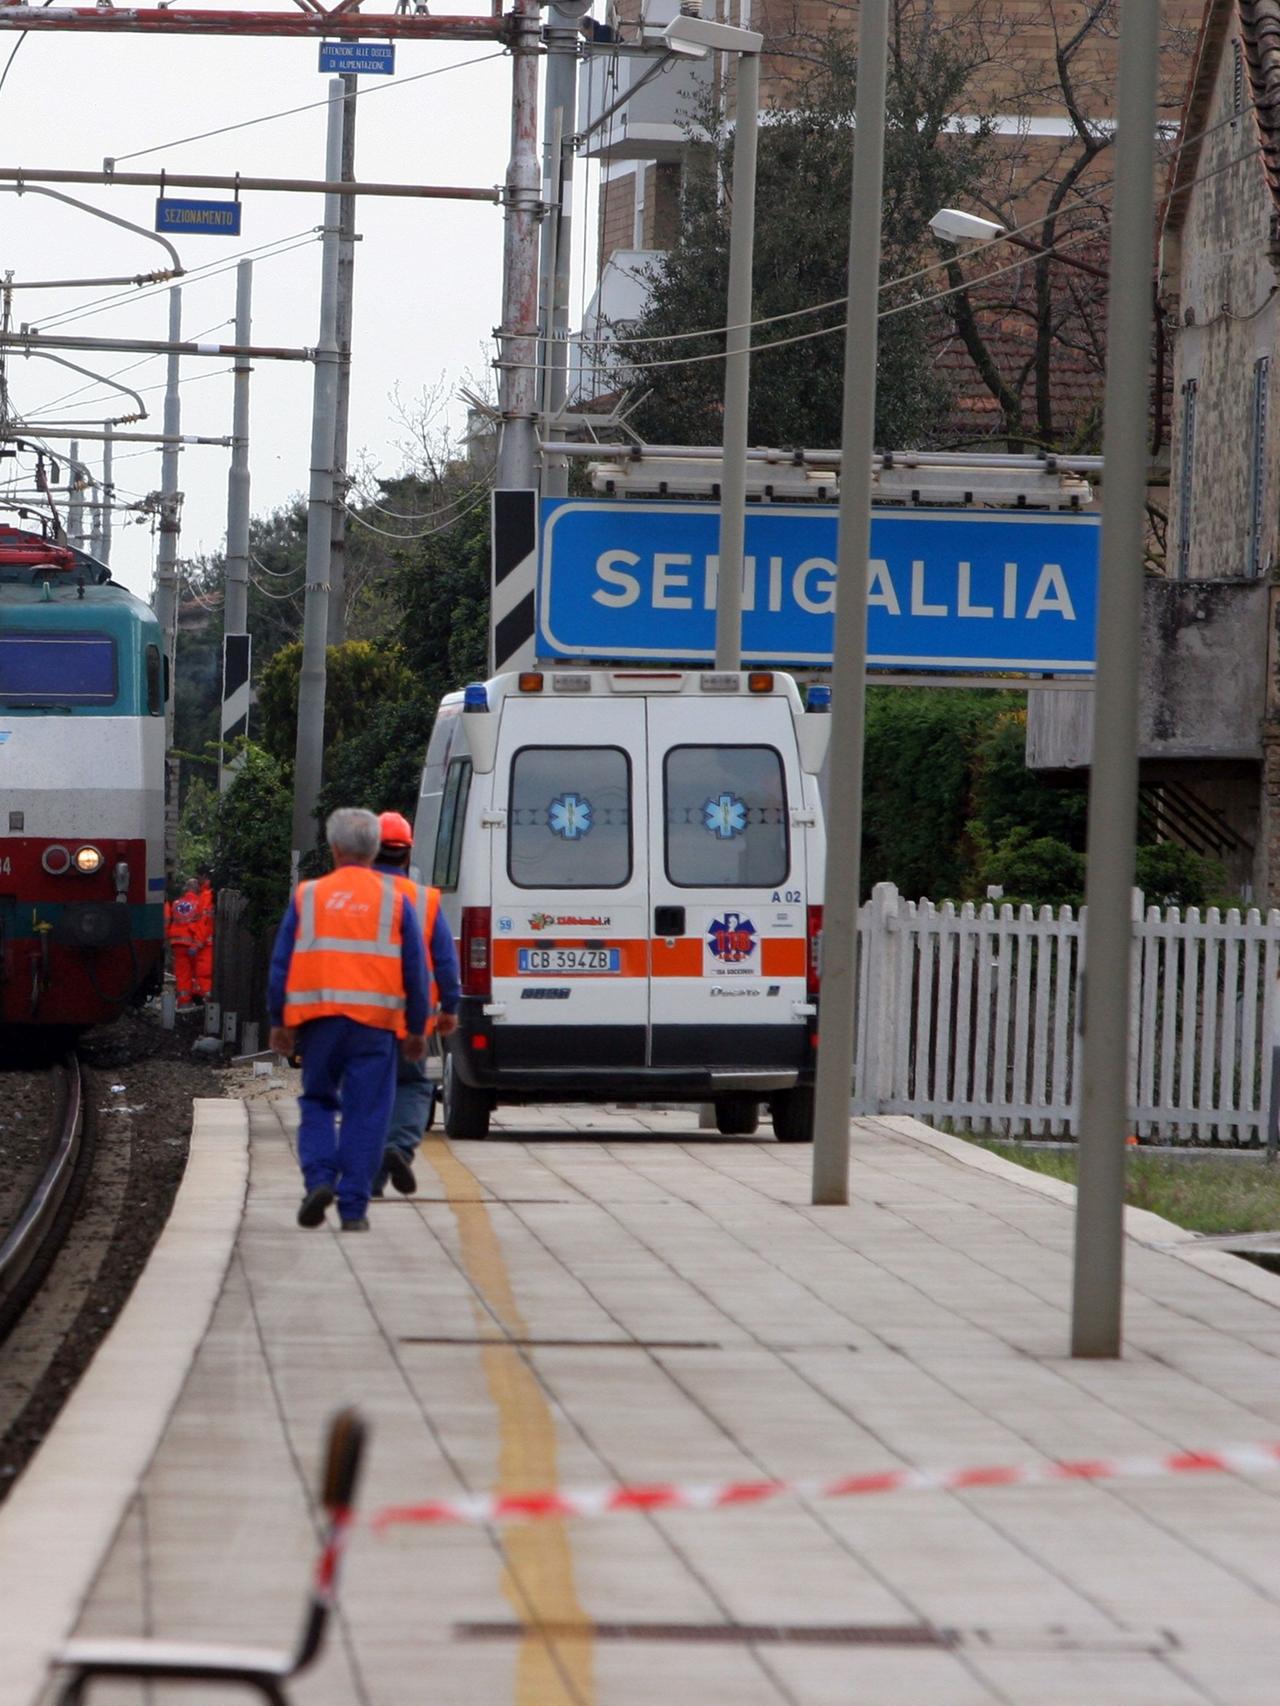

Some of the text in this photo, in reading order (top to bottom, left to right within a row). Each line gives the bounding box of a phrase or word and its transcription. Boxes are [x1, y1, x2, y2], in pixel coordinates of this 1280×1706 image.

[322, 46, 354, 57] ATTENZIONE
[355, 48, 369, 57] ALLE
[329, 59, 385, 70] DI ALIMENTAZIONE
[164, 207, 234, 226] SEZIONAMENTO
[591, 549, 1077, 621] SENIGALLIA
[771, 890, 802, 903] A 02
[500, 918, 512, 931] 59
[530, 951, 608, 969] CB 394ZB
